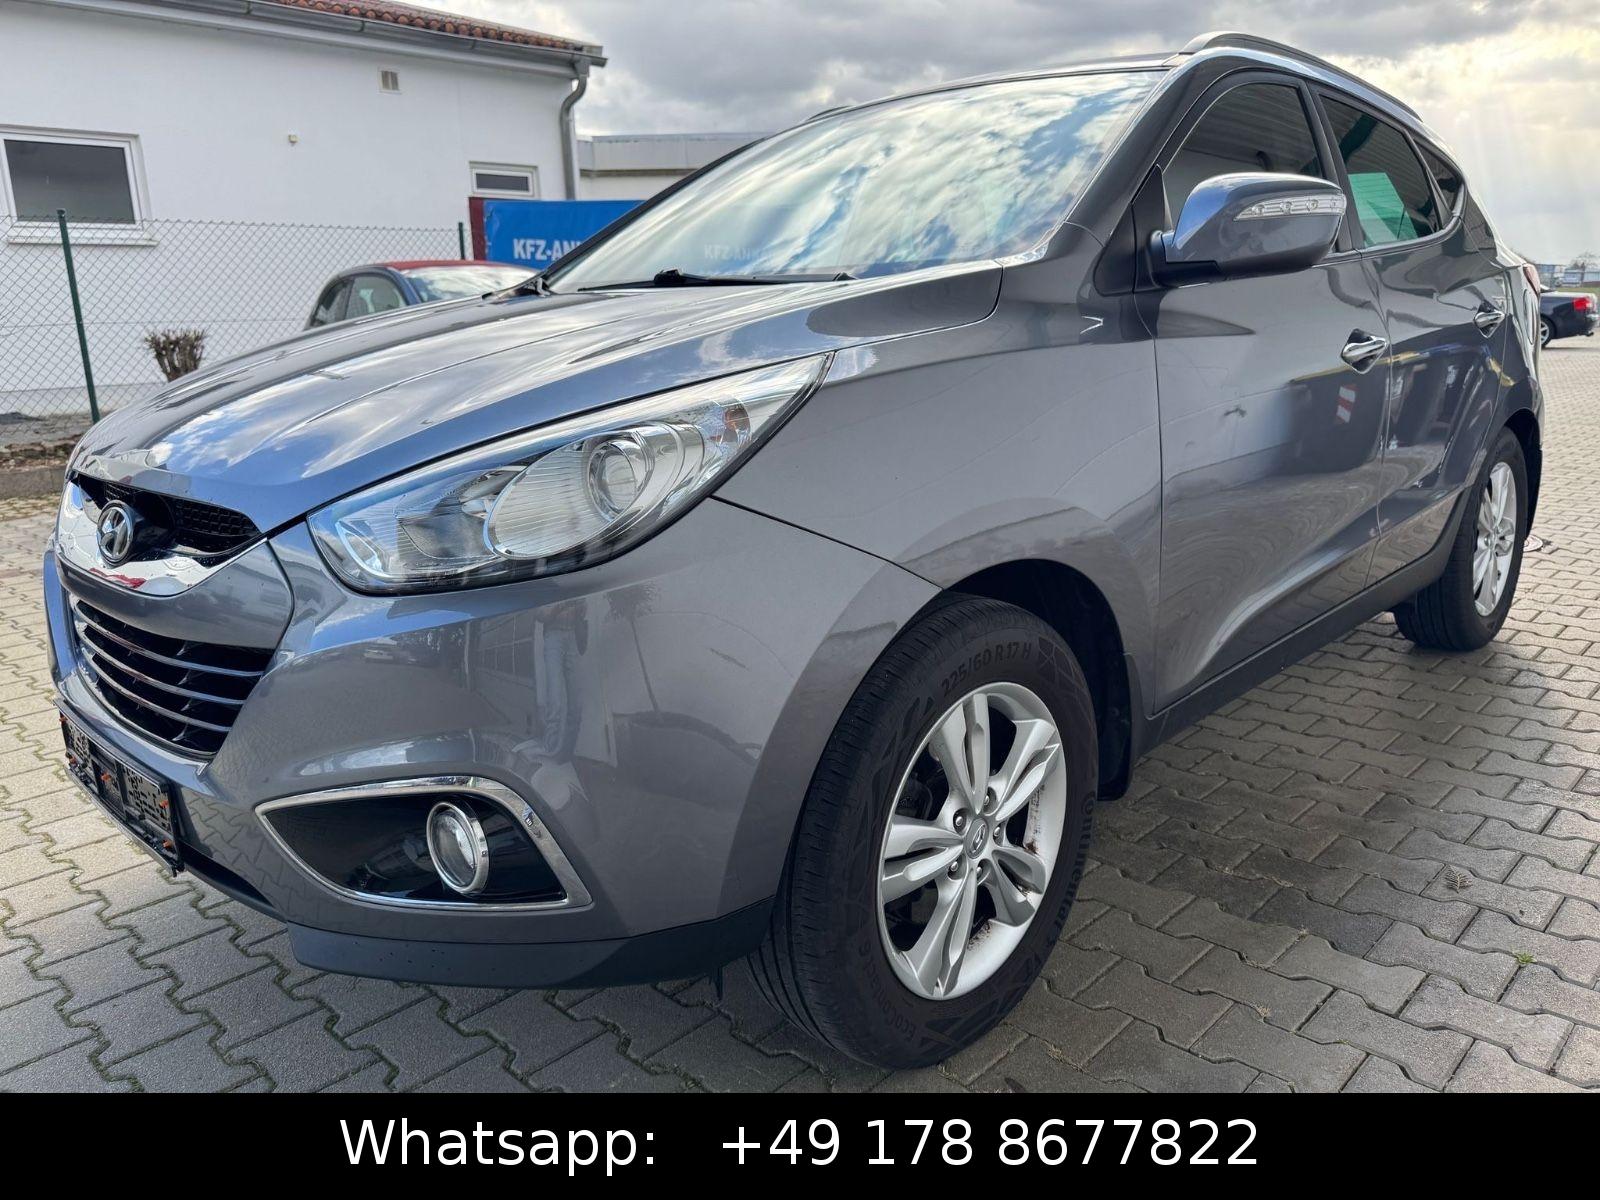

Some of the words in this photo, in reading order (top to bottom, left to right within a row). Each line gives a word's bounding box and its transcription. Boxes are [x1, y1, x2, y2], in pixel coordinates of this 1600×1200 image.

[513, 238, 584, 261] KFZ-AN
[941, 648, 992, 698] 225/60
[994, 643, 1004, 663] R
[1006, 641, 1020, 659] 17
[1022, 642, 1032, 660] H
